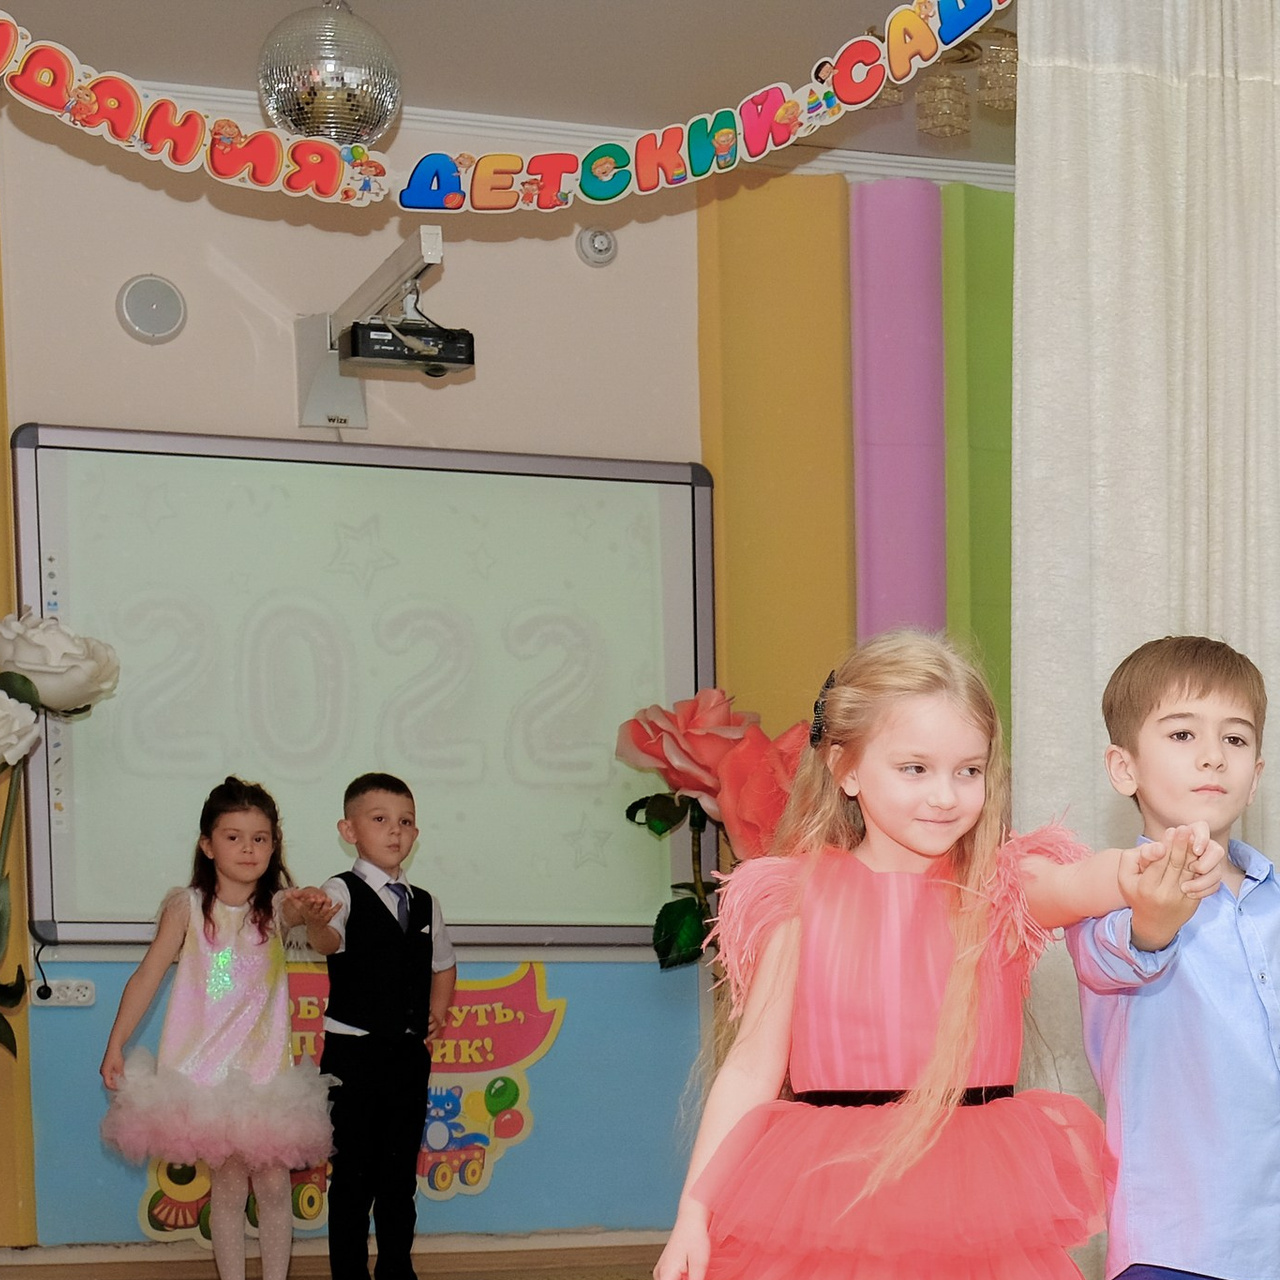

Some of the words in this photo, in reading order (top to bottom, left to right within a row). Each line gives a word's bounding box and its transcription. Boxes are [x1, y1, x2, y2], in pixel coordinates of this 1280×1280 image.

[0, 19, 358, 201] ДАНИЯ,
[400, 86, 800, 211] ДЕТСКИЙ
[832, 0, 1006, 106] САД
[111, 585, 615, 788] 2022
[441, 1002, 525, 1028] УТЬ,
